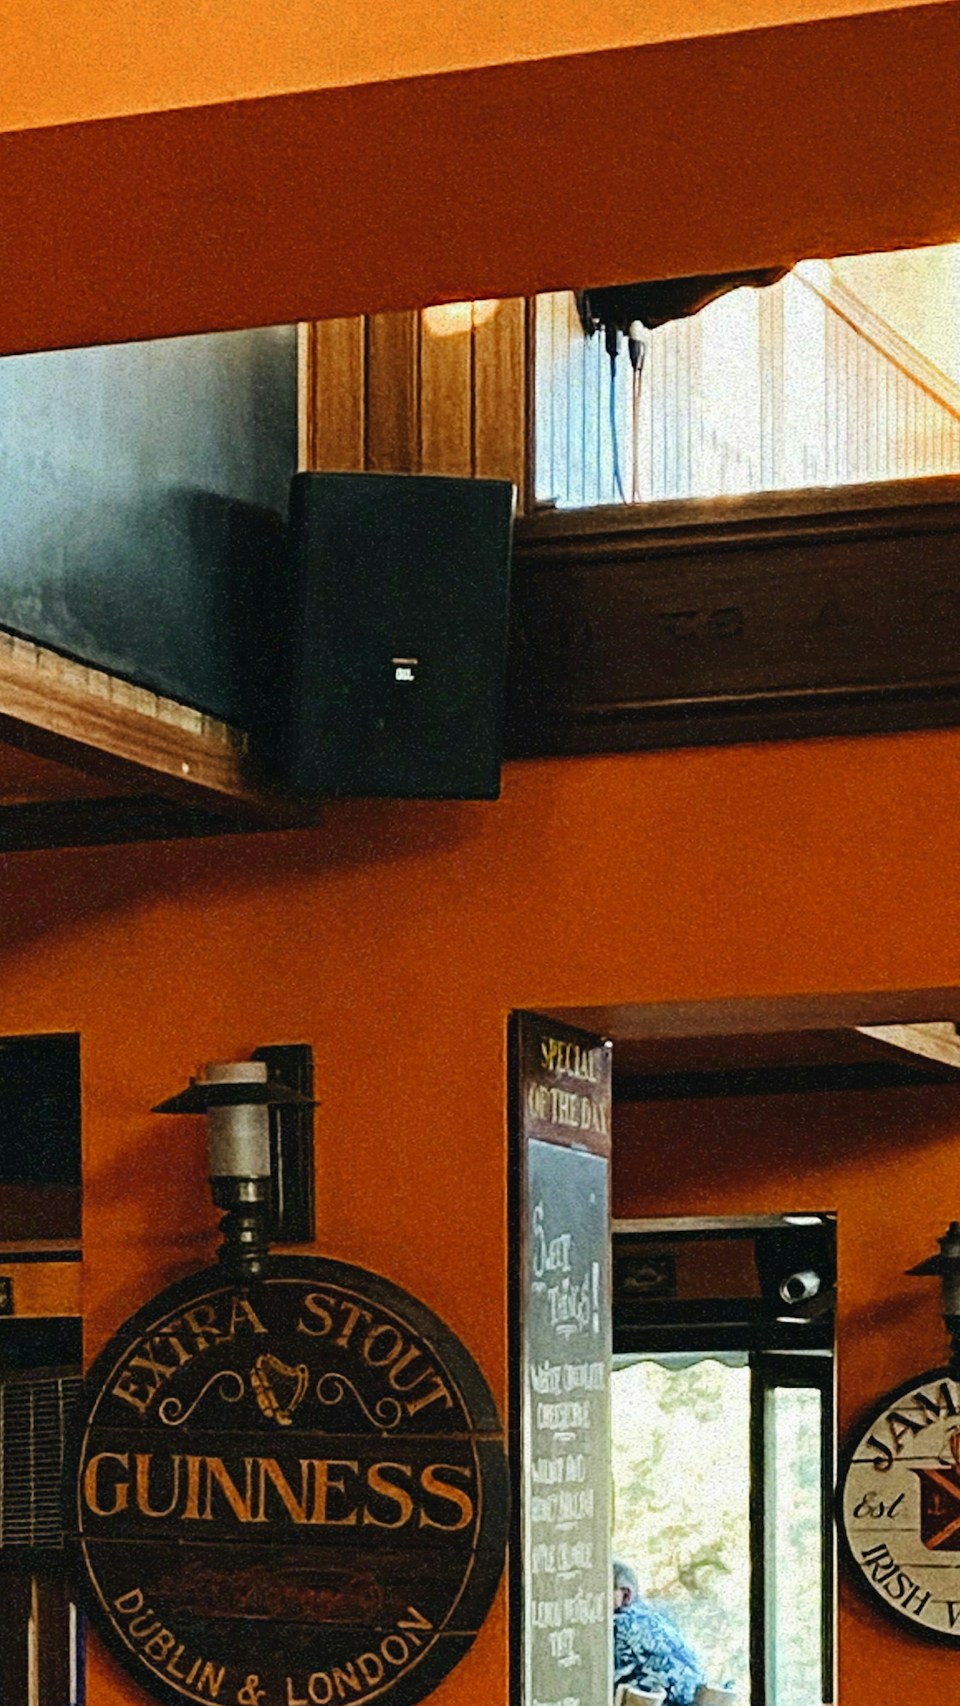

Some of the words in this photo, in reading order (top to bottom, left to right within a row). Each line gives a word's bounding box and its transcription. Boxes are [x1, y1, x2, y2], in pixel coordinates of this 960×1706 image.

[540, 1038, 597, 1083] SPECIAL
[528, 1083, 550, 1119] OF
[550, 1088, 580, 1127] THE
[581, 1096, 608, 1134] DAY
[112, 1294, 267, 1414] EXTRA
[297, 1292, 453, 1418] STOUT
[84, 1451, 474, 1532] GUINNESS
[861, 1543, 932, 1616] IRISH
[114, 1588, 226, 1698] DUBLIN
[238, 1674, 265, 1706] &
